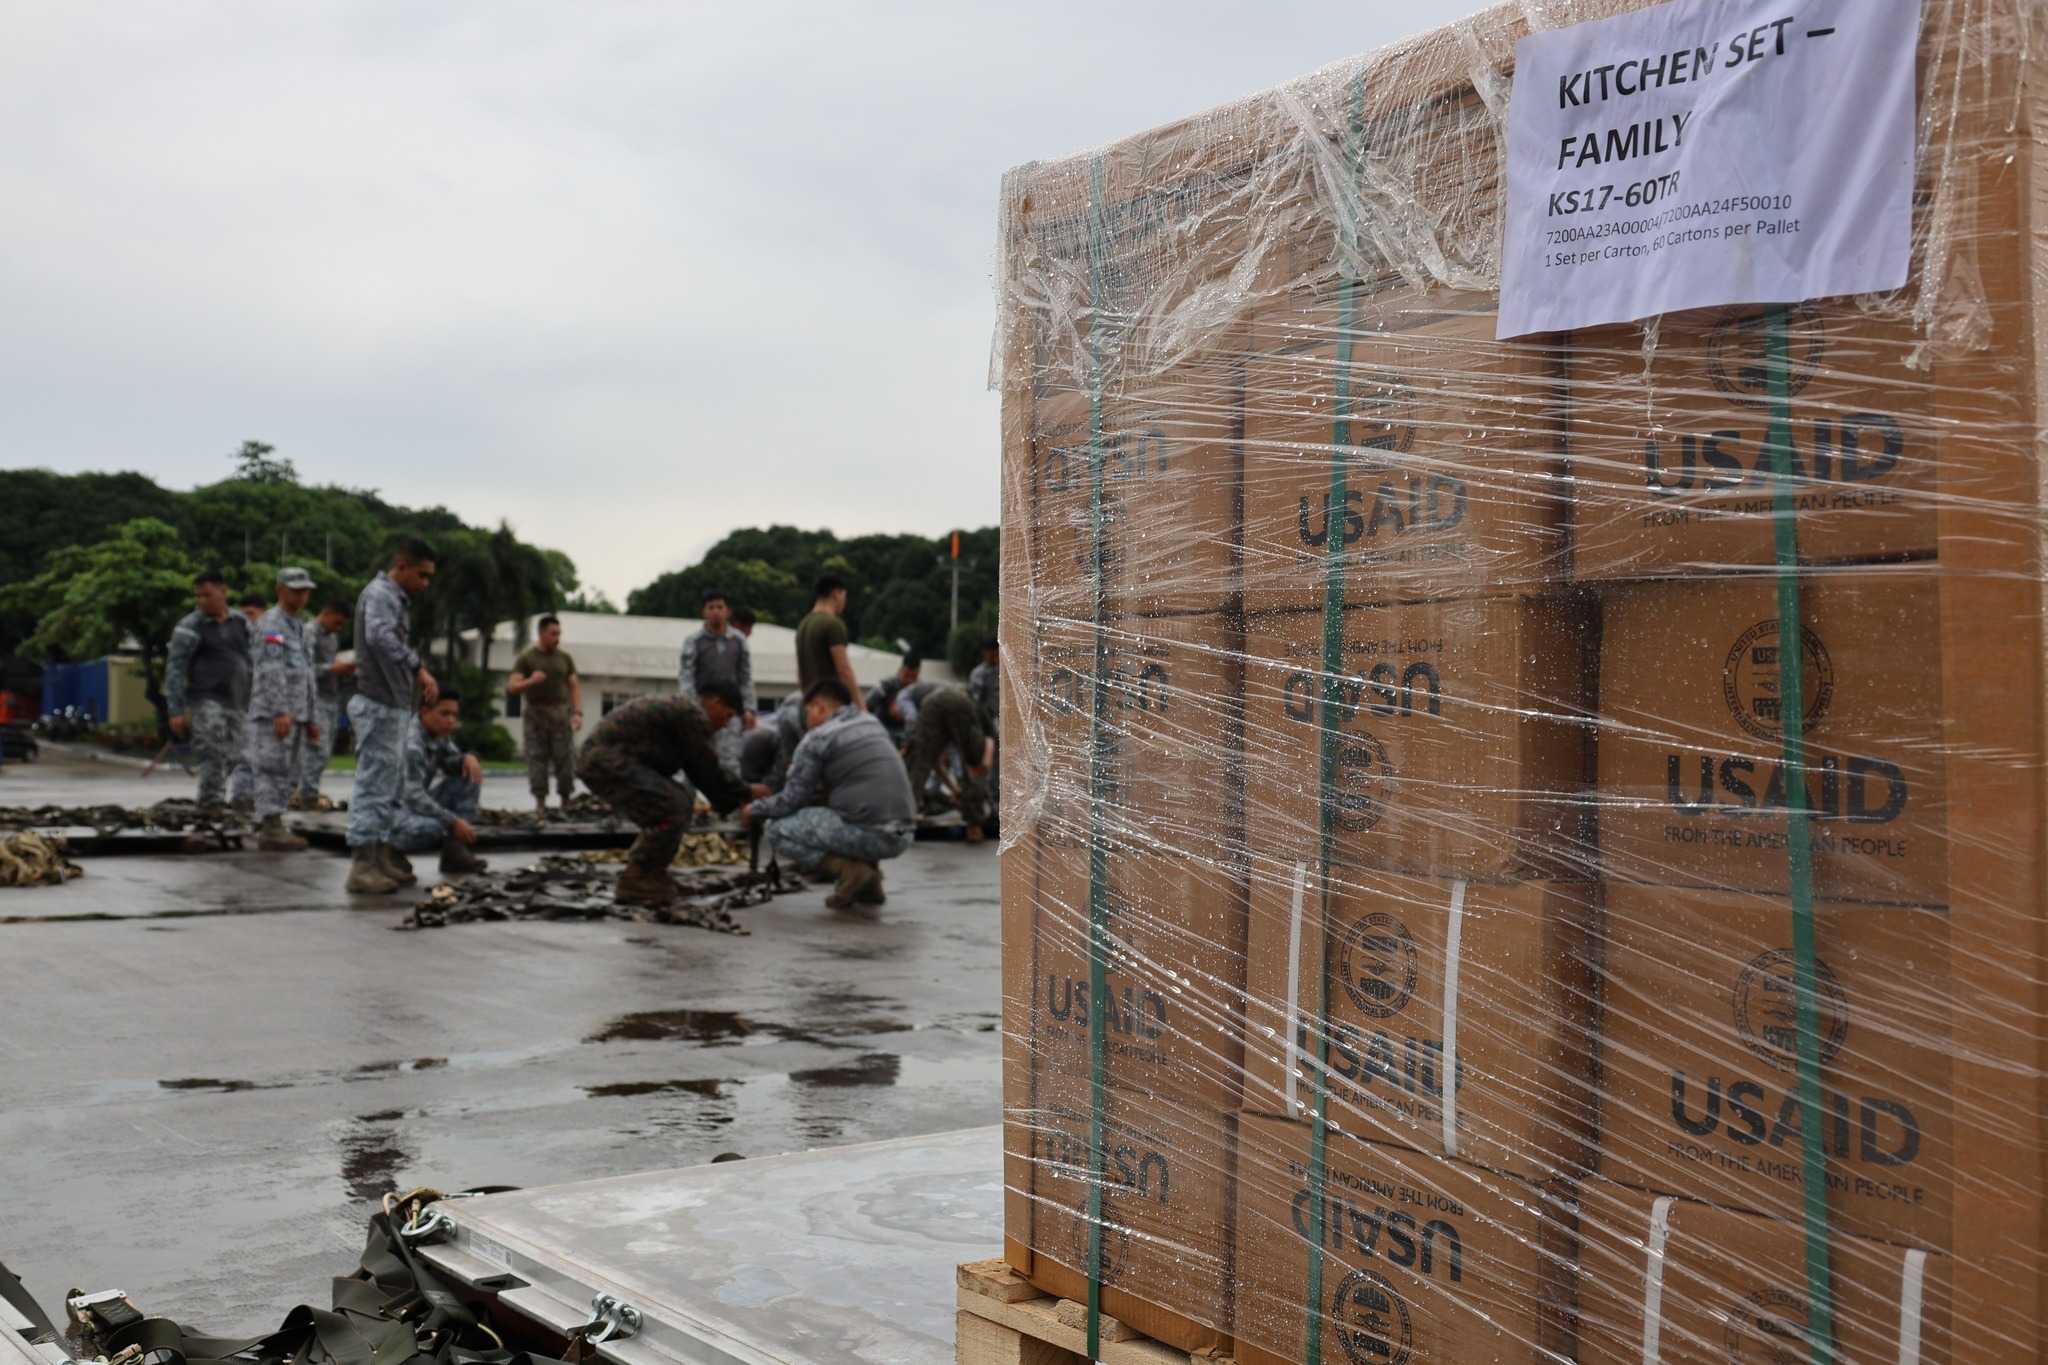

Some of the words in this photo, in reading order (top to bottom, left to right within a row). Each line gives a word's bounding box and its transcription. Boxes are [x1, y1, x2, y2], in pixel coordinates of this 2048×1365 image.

[1558, 41, 1719, 109] KITCHEN
[1725, 16, 1794, 69] SET
[1557, 110, 1693, 170] FAMILY
[1548, 170, 1680, 217] KS17-60TR
[1545, 254, 1552, 268] 1
[1555, 252, 1577, 267] Set
[1580, 250, 1601, 266] per
[1604, 243, 1650, 260] Carton,
[1653, 234, 1665, 252] 60
[1666, 227, 1720, 247] Cartons
[1724, 223, 1752, 240] per
[1756, 218, 1801, 235] Pallet
[1645, 412, 1904, 497] USAID
[1299, 473, 1470, 547] USAID
[1734, 493, 1827, 514] AMEAN
[1050, 665, 1168, 713] USID
[1284, 661, 1441, 724] USAD
[1667, 755, 1908, 825] USAID
[1664, 826, 1708, 844] FROM
[1745, 831, 1835, 852] AMEAN
[1297, 1014, 1464, 1096] USAID
[1671, 1070, 1921, 1168] USAID
[1398, 1186, 1424, 1207] THE
[1667, 1141, 1713, 1163] FROM
[1718, 1151, 1751, 1173] THE
[1756, 1160, 1849, 1192] AMERAN
[1854, 1177, 1924, 1204] PEOPLE
[1291, 1189, 1462, 1283] USAID
[1426, 1194, 1464, 1217] FROM
